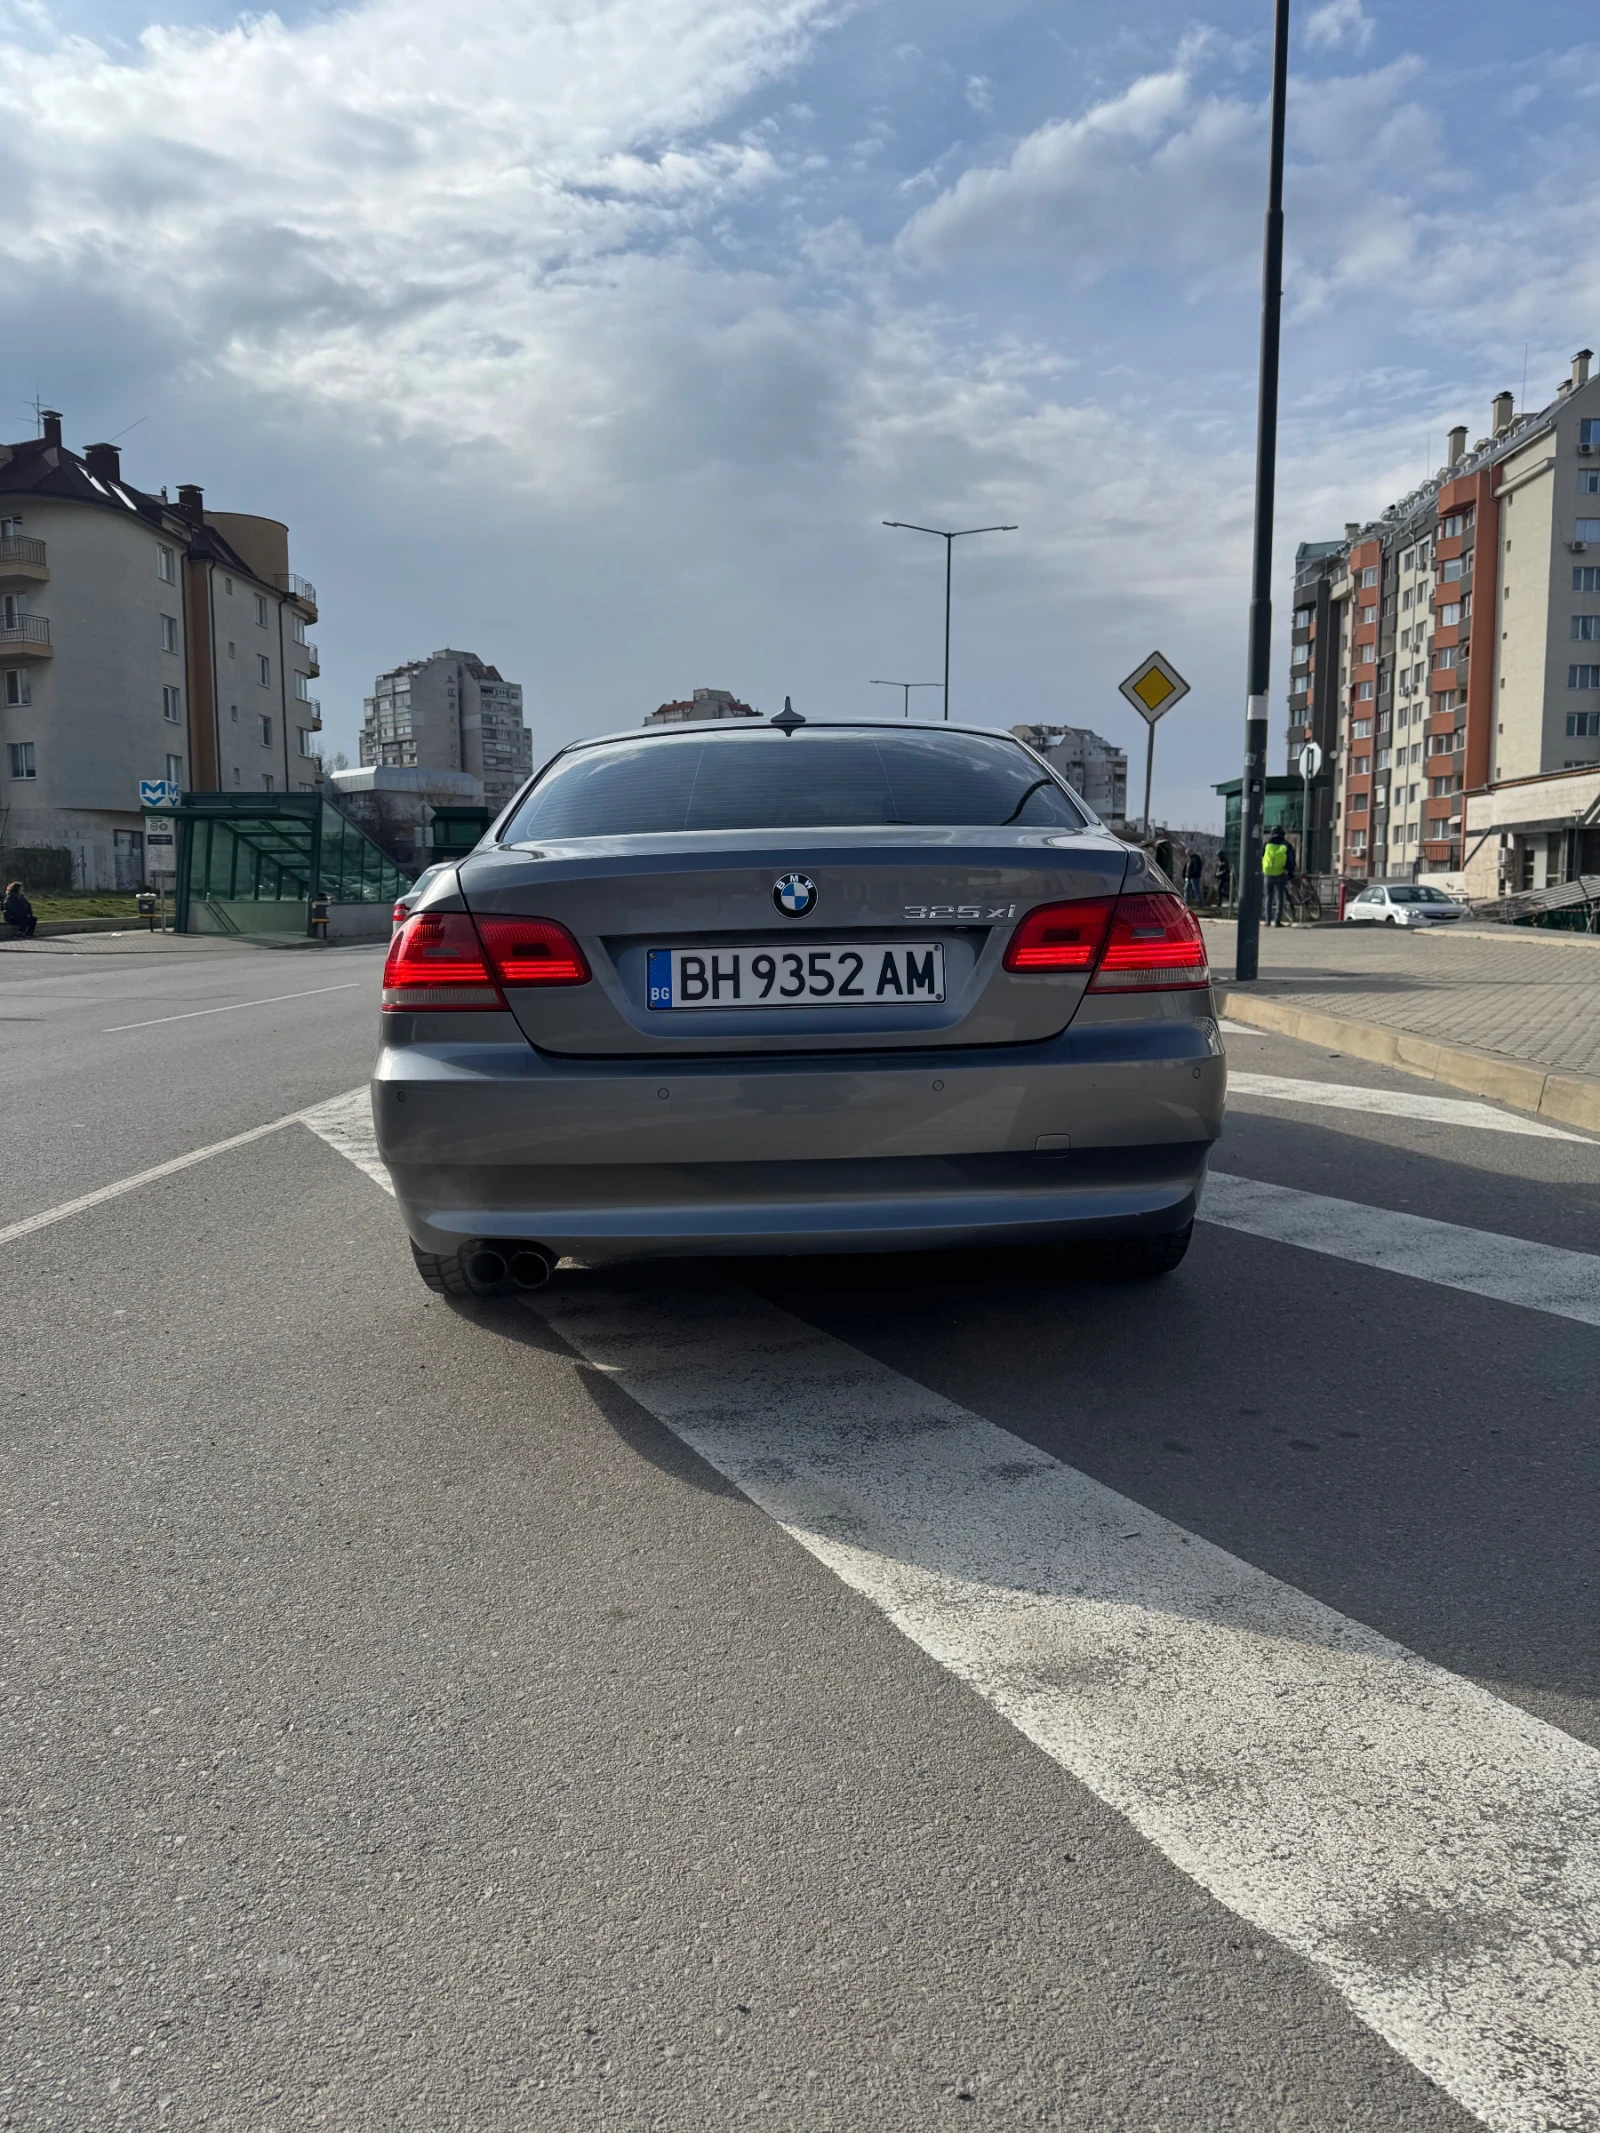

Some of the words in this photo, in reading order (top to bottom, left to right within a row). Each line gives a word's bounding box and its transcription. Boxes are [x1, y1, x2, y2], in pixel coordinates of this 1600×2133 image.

[776, 875, 814, 890] BMW
[681, 955, 741, 1001] BH
[752, 952, 864, 999] 9352
[876, 951, 935, 995] AM
[651, 987, 670, 1000] BG
